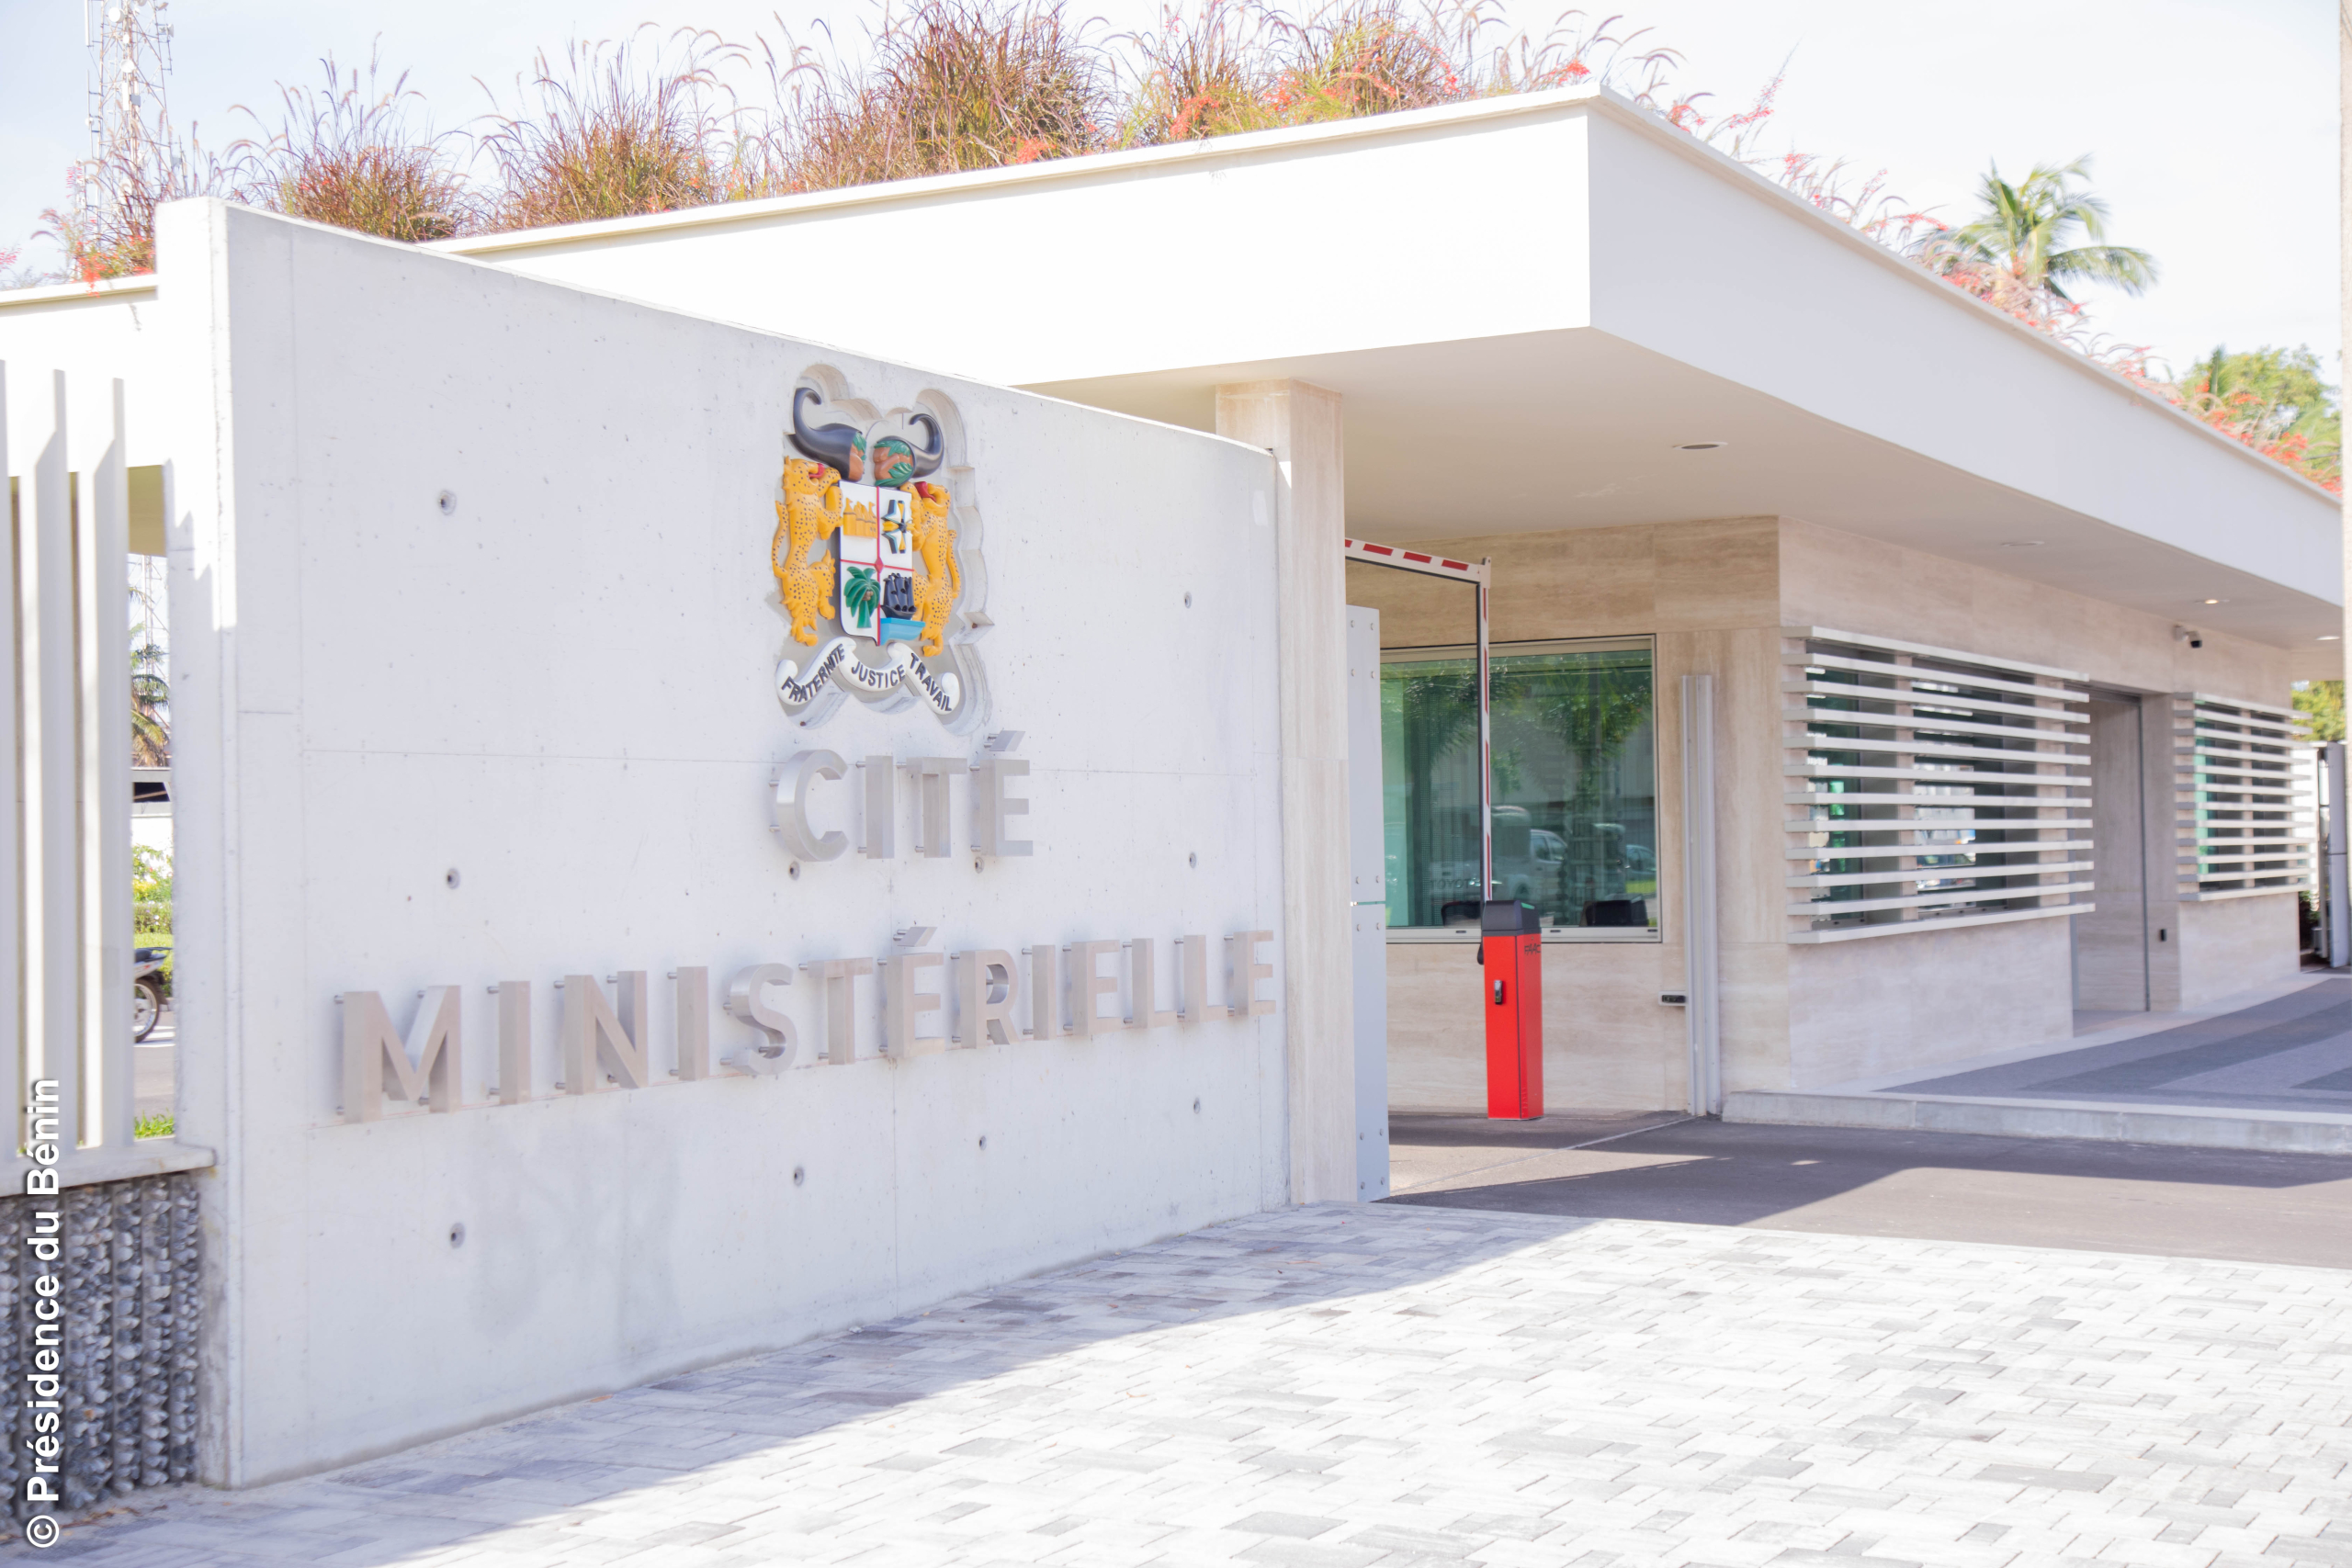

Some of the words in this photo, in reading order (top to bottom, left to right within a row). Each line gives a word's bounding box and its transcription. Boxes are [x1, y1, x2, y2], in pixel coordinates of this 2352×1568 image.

[781, 643, 845, 703] FRATERNITE
[851, 661, 906, 688] JUSTICE
[910, 653, 953, 712] TRAVAIL
[775, 730, 1034, 862] CITÉ
[343, 926, 1277, 1124] MINISTÉRIELLE
